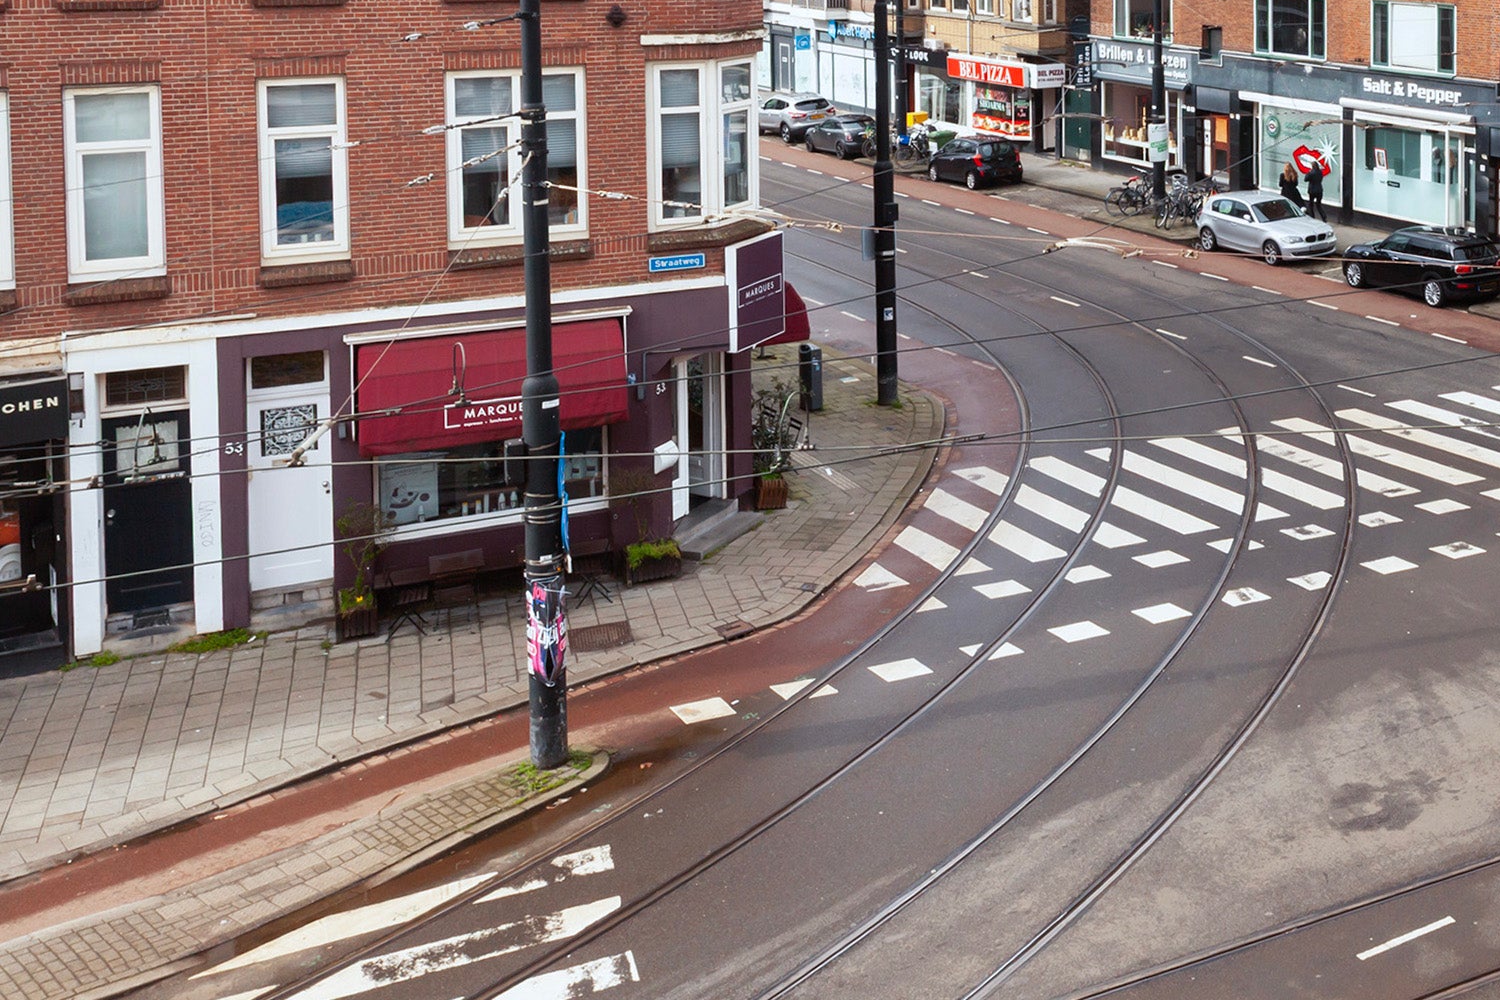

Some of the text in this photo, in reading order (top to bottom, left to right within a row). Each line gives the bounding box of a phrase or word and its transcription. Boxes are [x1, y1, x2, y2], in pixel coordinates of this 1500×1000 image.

[1099, 44, 1187, 69] Brillen & Lnzen
[958, 61, 1012, 84] BEL PIZZA
[1363, 77, 1462, 104] Salt & Pepper
[655, 257, 700, 267] Straatweg
[745, 281, 775, 298] MARQUES
[656, 382, 666, 395] 53
[1, 396, 58, 414] CHEN
[464, 402, 523, 419] MARQUE
[224, 441, 244, 455] 53
